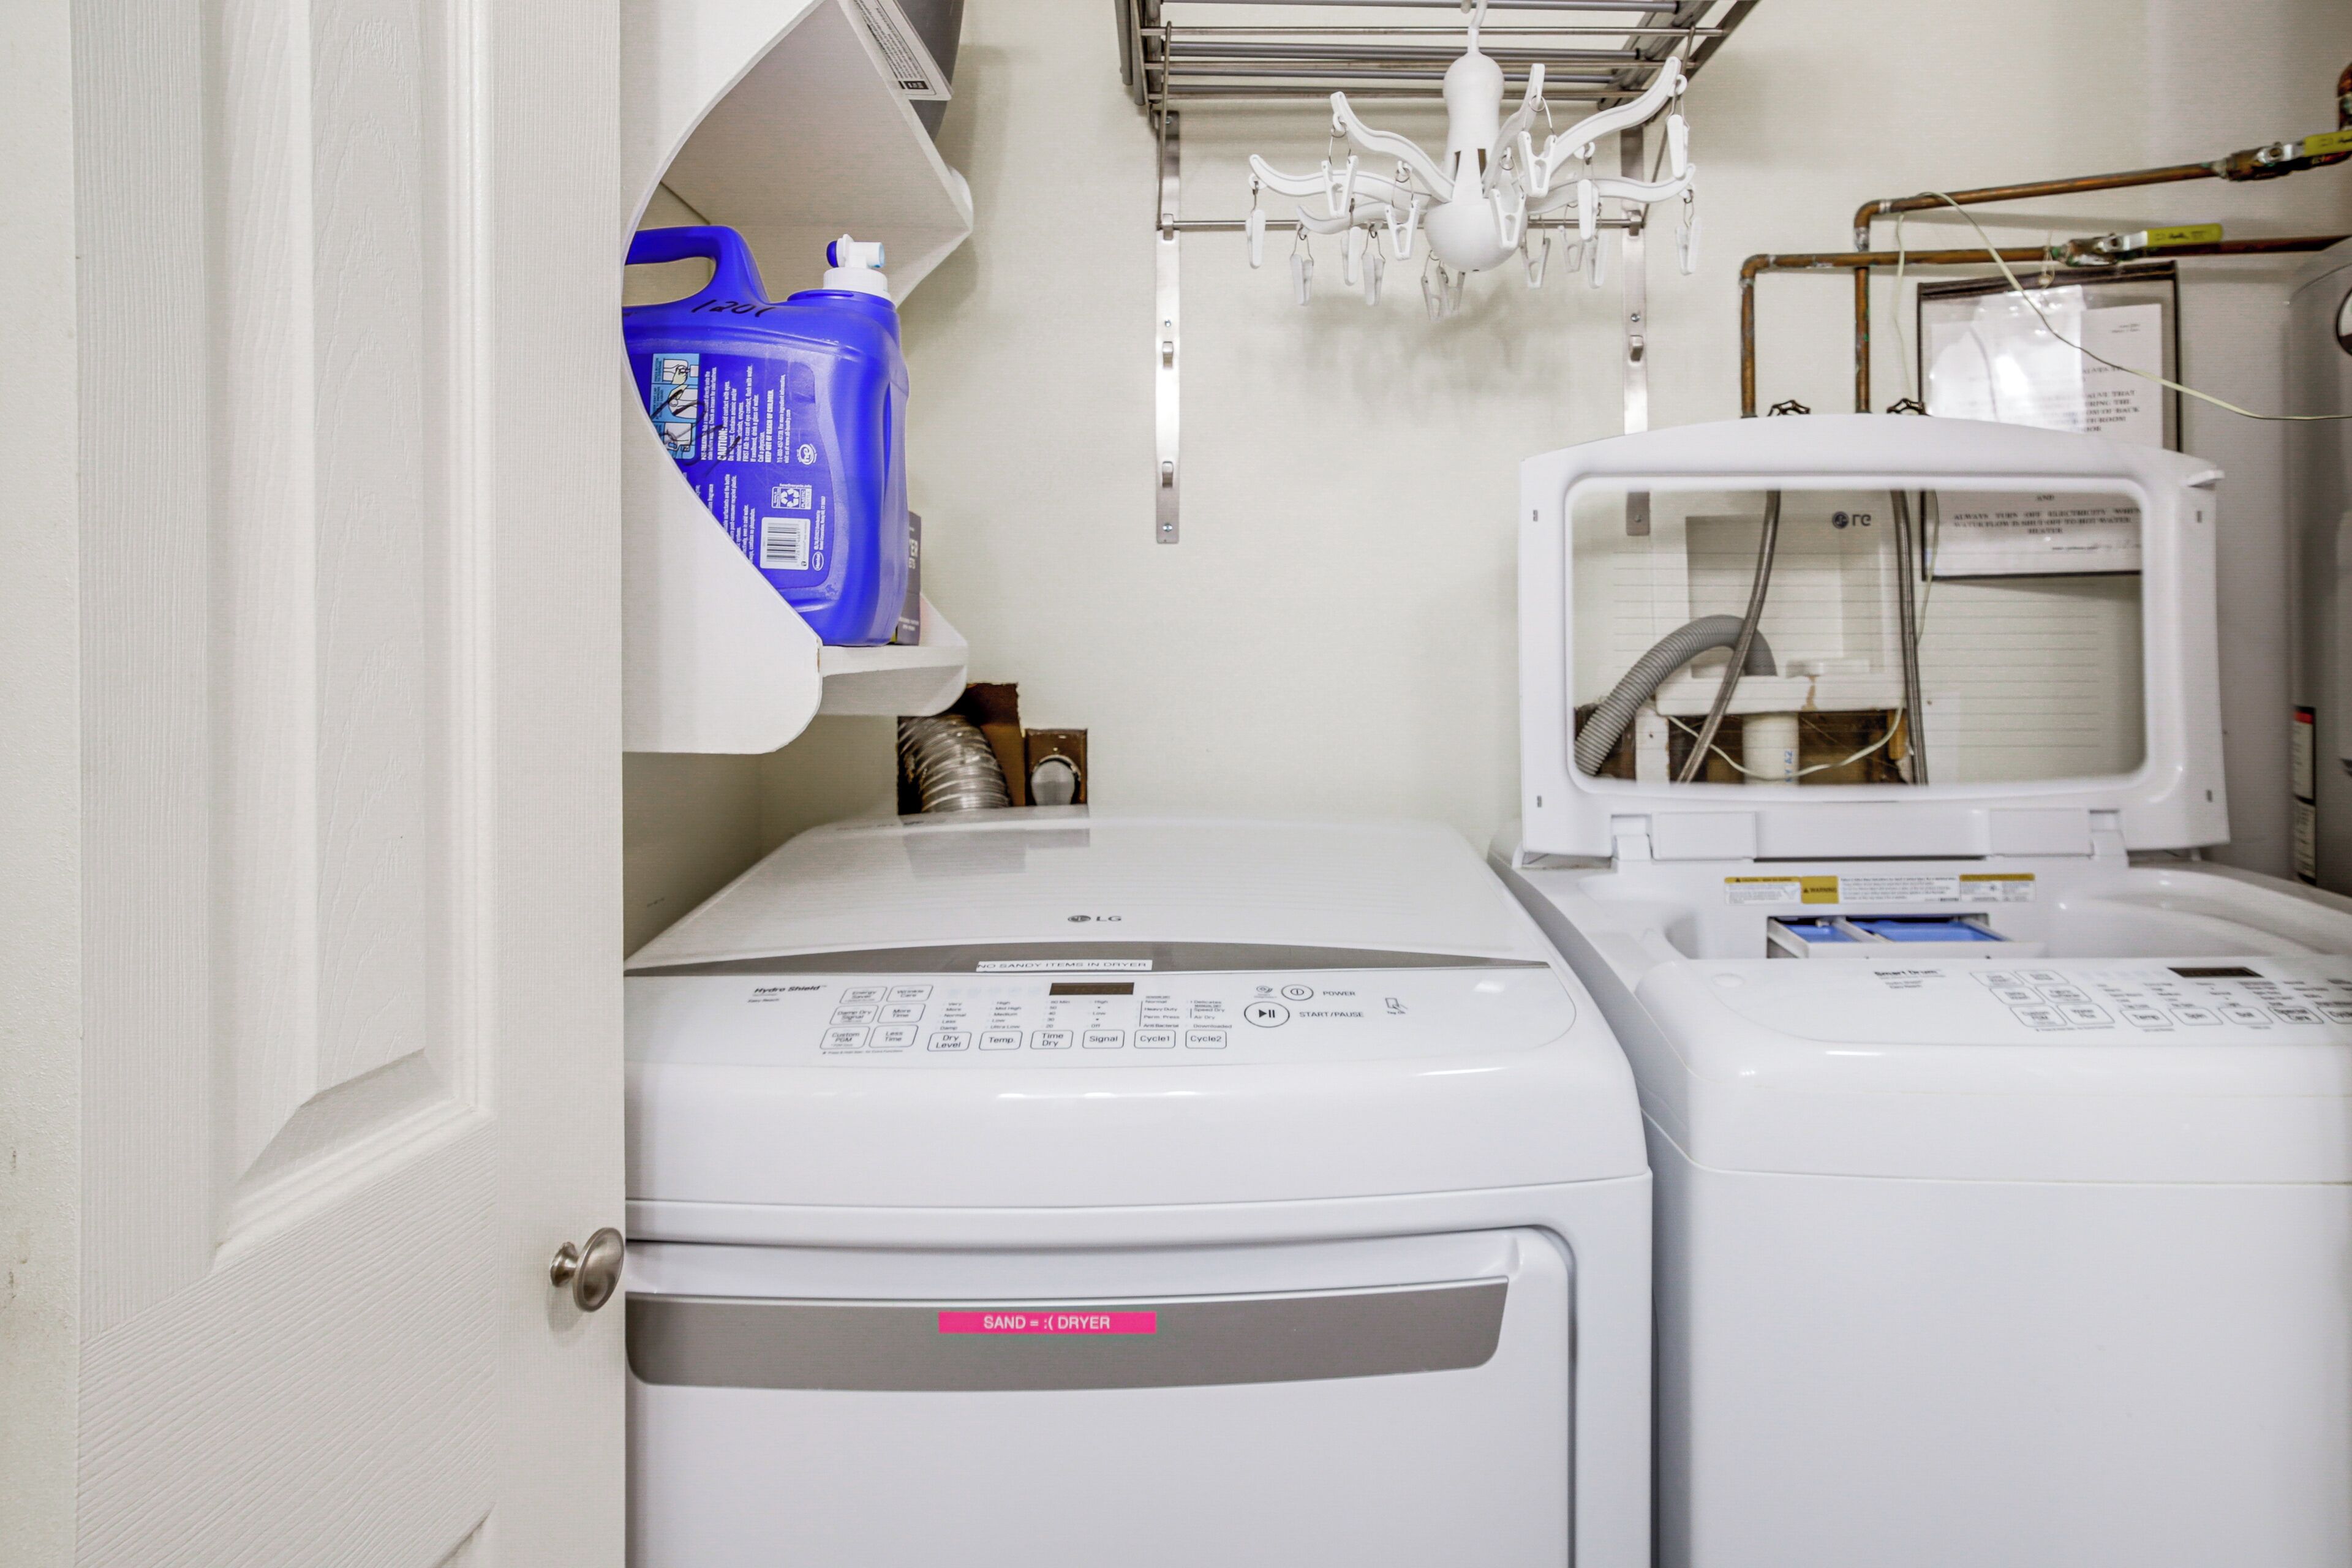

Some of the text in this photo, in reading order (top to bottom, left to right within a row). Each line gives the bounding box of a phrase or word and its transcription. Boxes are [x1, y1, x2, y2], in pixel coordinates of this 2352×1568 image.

[717, 428, 728, 461] CAUTION:
[983, 1315, 1111, 1331] SAND = :( DRYER
